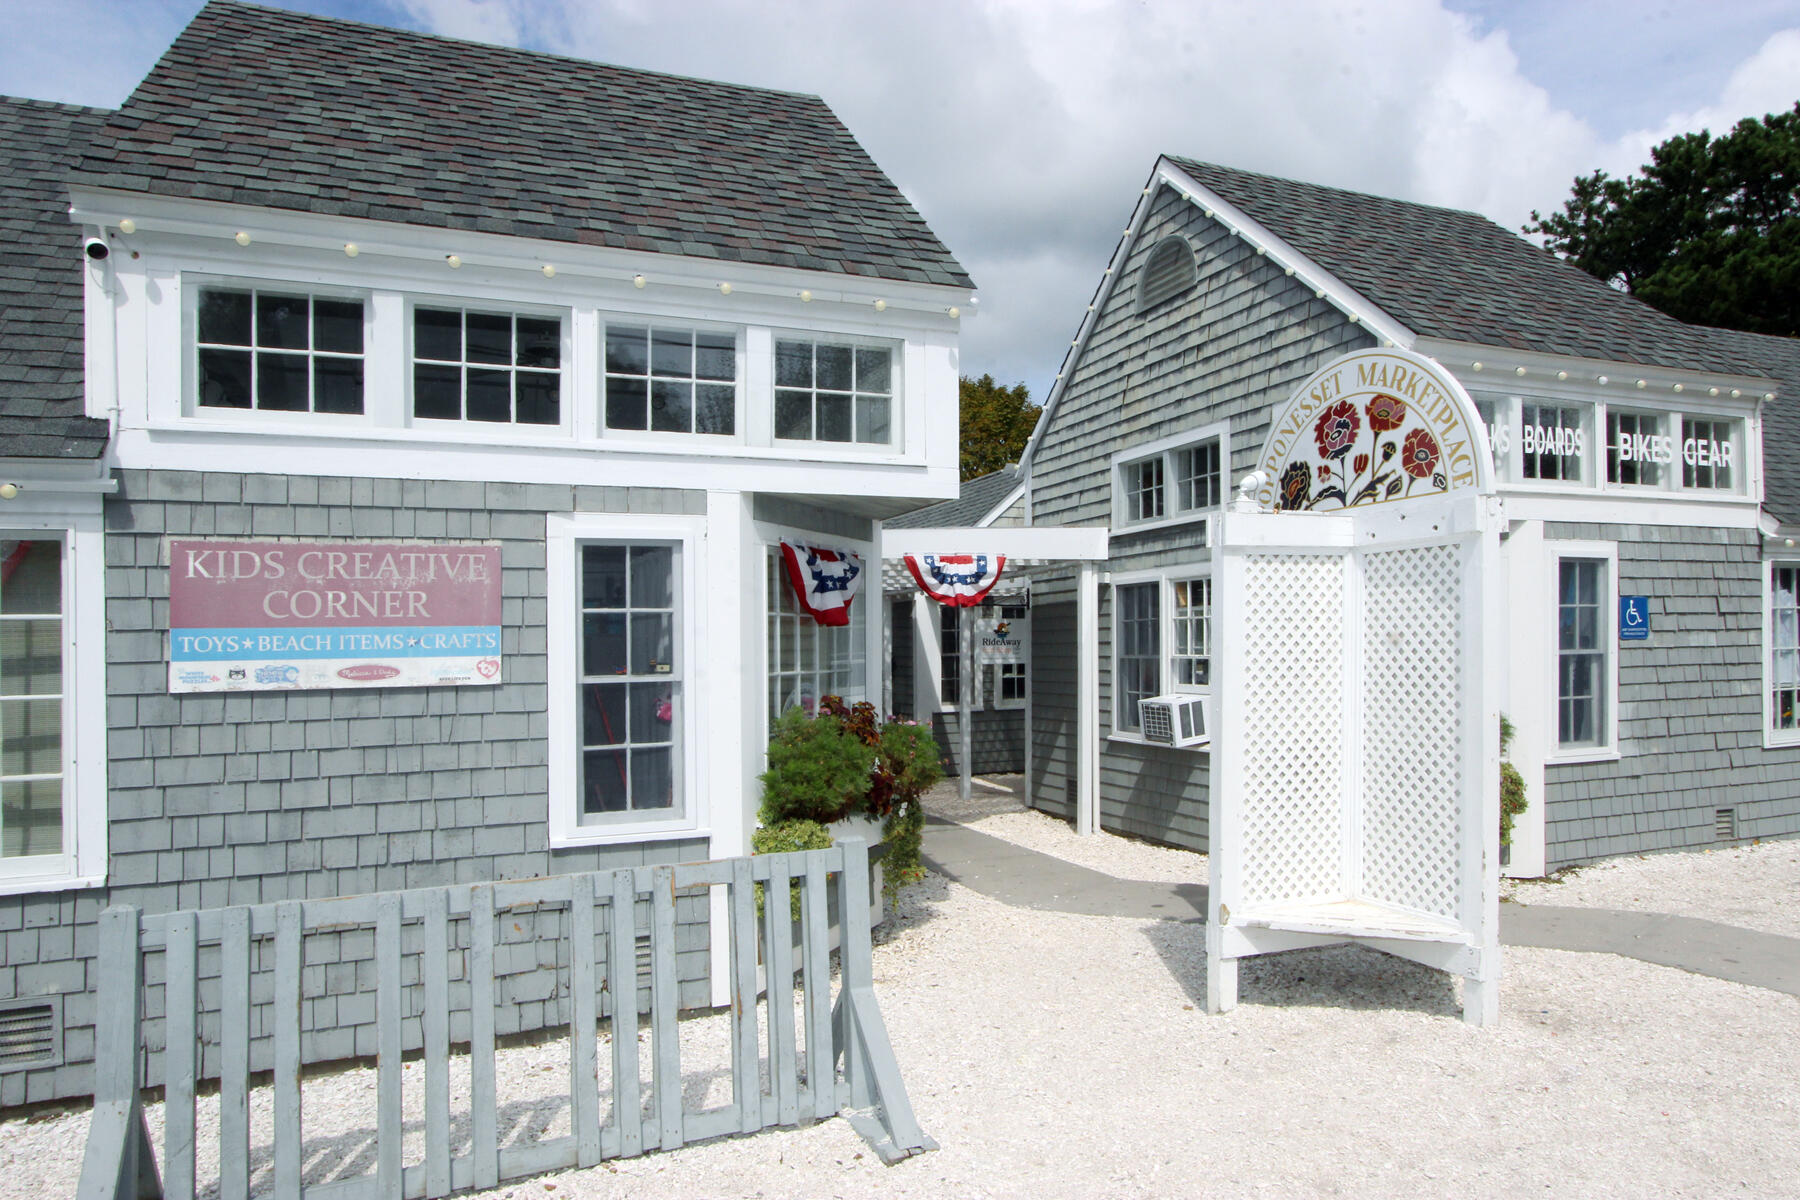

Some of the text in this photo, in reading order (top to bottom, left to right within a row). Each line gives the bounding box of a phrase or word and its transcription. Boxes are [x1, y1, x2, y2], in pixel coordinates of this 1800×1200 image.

[1258, 362, 1474, 508] OPPONESSET MARKETPLACE
[1524, 424, 1584, 456] BOARDS
[1619, 433, 1673, 464] BIKES
[1684, 438, 1732, 467] GEAR
[185, 550, 487, 581] KIDS CREATIVE
[262, 590, 431, 619] CORNER
[178, 633, 496, 653] TOYS BEACH ITEMS CRAFTS
[982, 637, 1022, 648] RideAway
